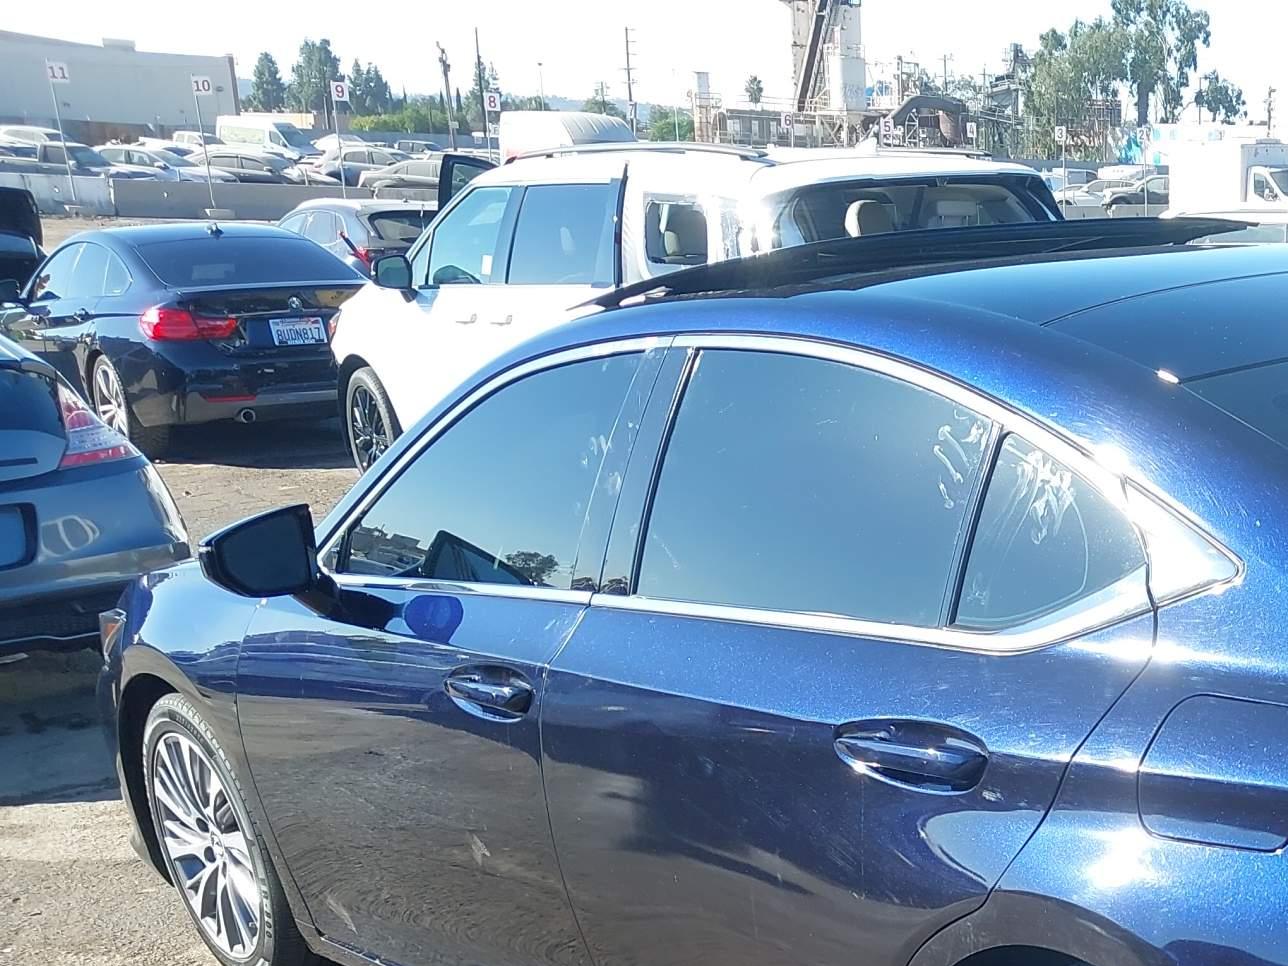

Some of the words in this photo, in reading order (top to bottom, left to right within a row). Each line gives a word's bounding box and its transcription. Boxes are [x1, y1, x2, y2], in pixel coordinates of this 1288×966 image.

[48, 65, 69, 80] 11
[192, 79, 211, 92] 10
[335, 84, 345, 99] 9
[488, 95, 497, 109] 8
[784, 114, 792, 127] 6
[884, 120, 891, 134] 5
[969, 124, 975, 135] 4
[1057, 128, 1063, 139] 3
[1138, 129, 1145, 140] 2
[276, 326, 321, 342] 8UDN817
